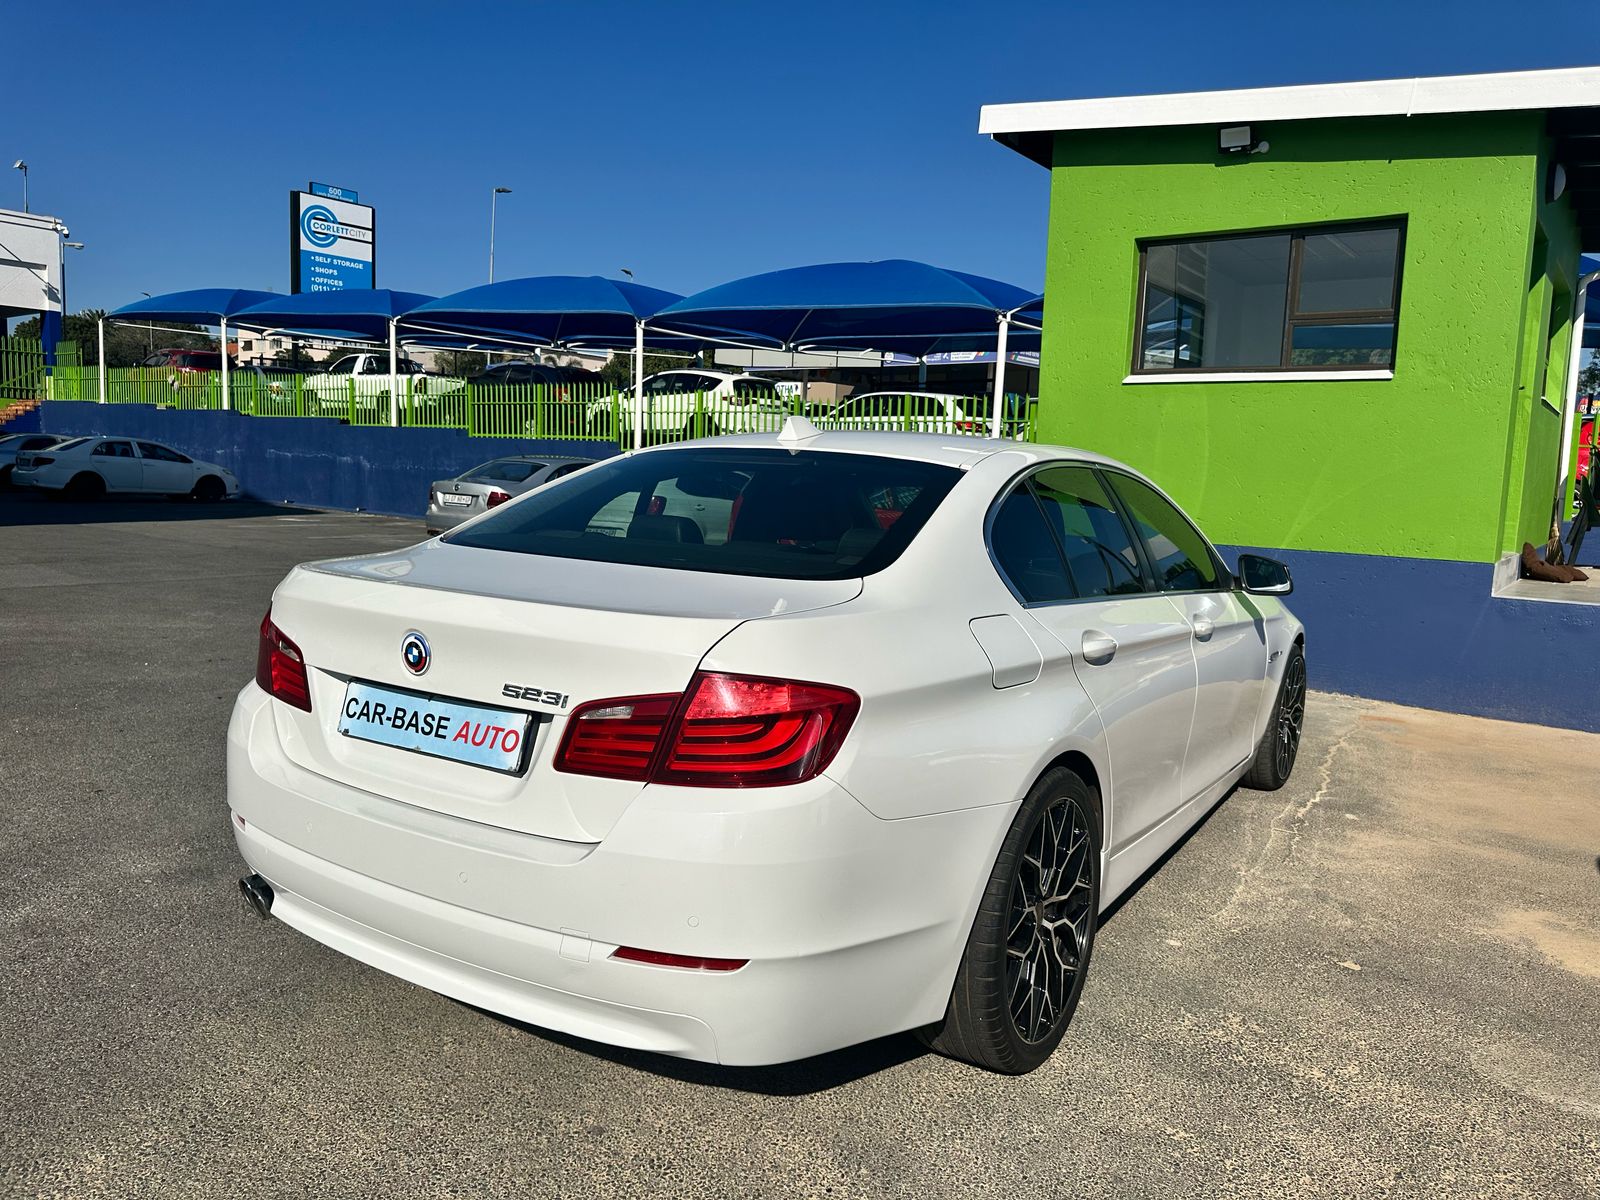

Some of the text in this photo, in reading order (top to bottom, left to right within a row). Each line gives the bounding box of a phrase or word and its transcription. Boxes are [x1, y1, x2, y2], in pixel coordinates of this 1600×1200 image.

[328, 187, 342, 196] 600
[333, 260, 364, 269] STORAGE
[315, 266, 338, 275] SHOPS
[315, 277, 343, 286] OFFICES
[345, 697, 520, 753] CAR-BASE AUTO
